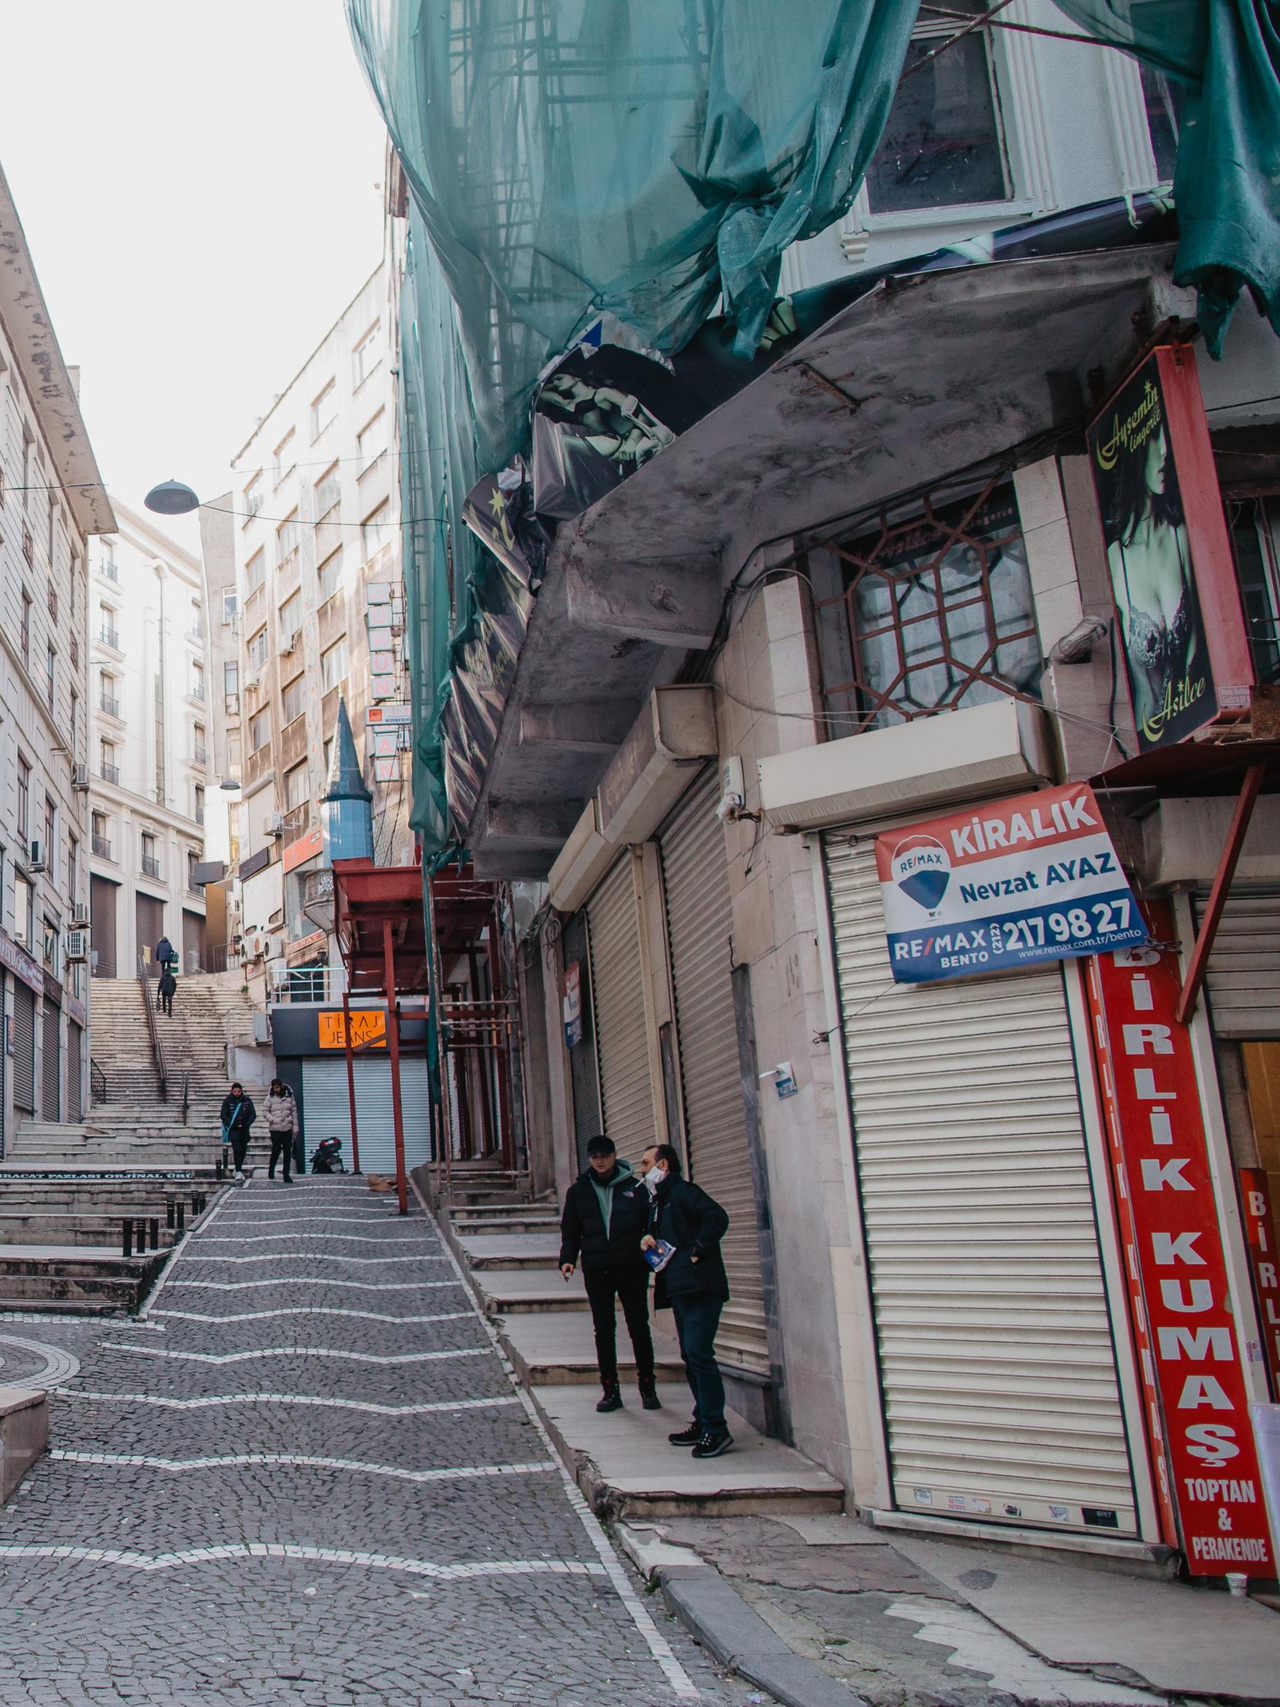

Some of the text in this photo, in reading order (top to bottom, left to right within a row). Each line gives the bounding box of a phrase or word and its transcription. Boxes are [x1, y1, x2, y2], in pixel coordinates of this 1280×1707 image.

[1143, 676, 1206, 736] Asilce
[951, 796, 1098, 858] KİRALIK
[900, 853, 943, 874] RE/MAX
[959, 852, 1117, 904] Nevzat AYAZ
[1002, 916, 1044, 951] 217
[1048, 907, 1093, 942] 98
[1091, 898, 1132, 935] 27
[894, 928, 988, 961] RE/MAX
[1018, 928, 1142, 959] www.remax.com.tr/bento
[940, 952, 989, 969] BENTO
[1151, 1232, 1240, 1468] KUMAŞ
[1184, 1478, 1256, 1503] TOPTAN
[1218, 1508, 1233, 1531] &
[1192, 1537, 1268, 1562] PERAKENDE
